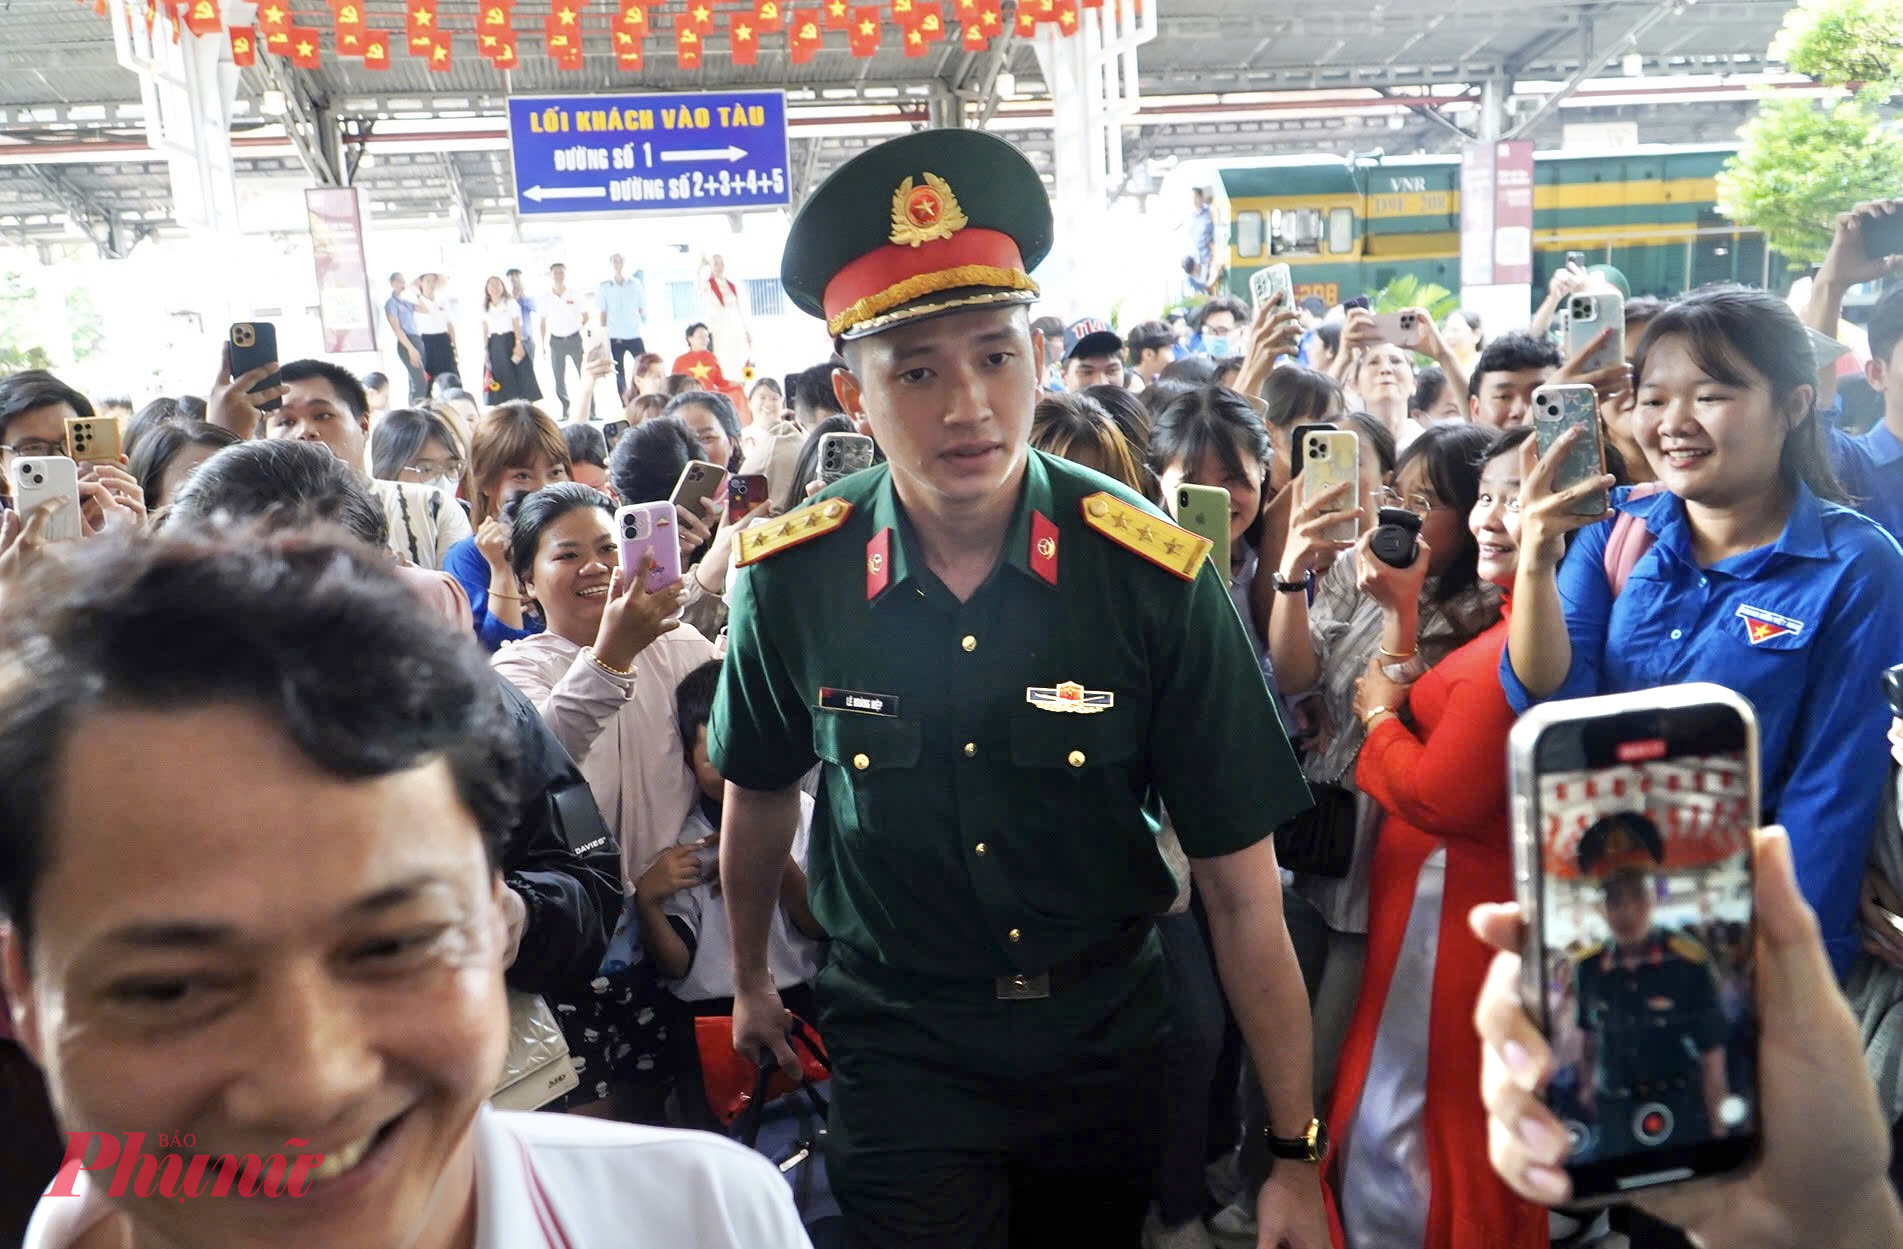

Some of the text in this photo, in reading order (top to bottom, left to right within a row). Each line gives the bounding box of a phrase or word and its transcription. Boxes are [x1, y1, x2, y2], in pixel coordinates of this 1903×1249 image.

[530, 102, 765, 133] LỐI KHÁCH VÀO TÀU
[553, 141, 653, 171] ĐƯỜNG SỐ 1
[609, 167, 784, 201] ĐƯỜNG SỐ 2+3+4+5
[1390, 176, 1426, 192] VNR
